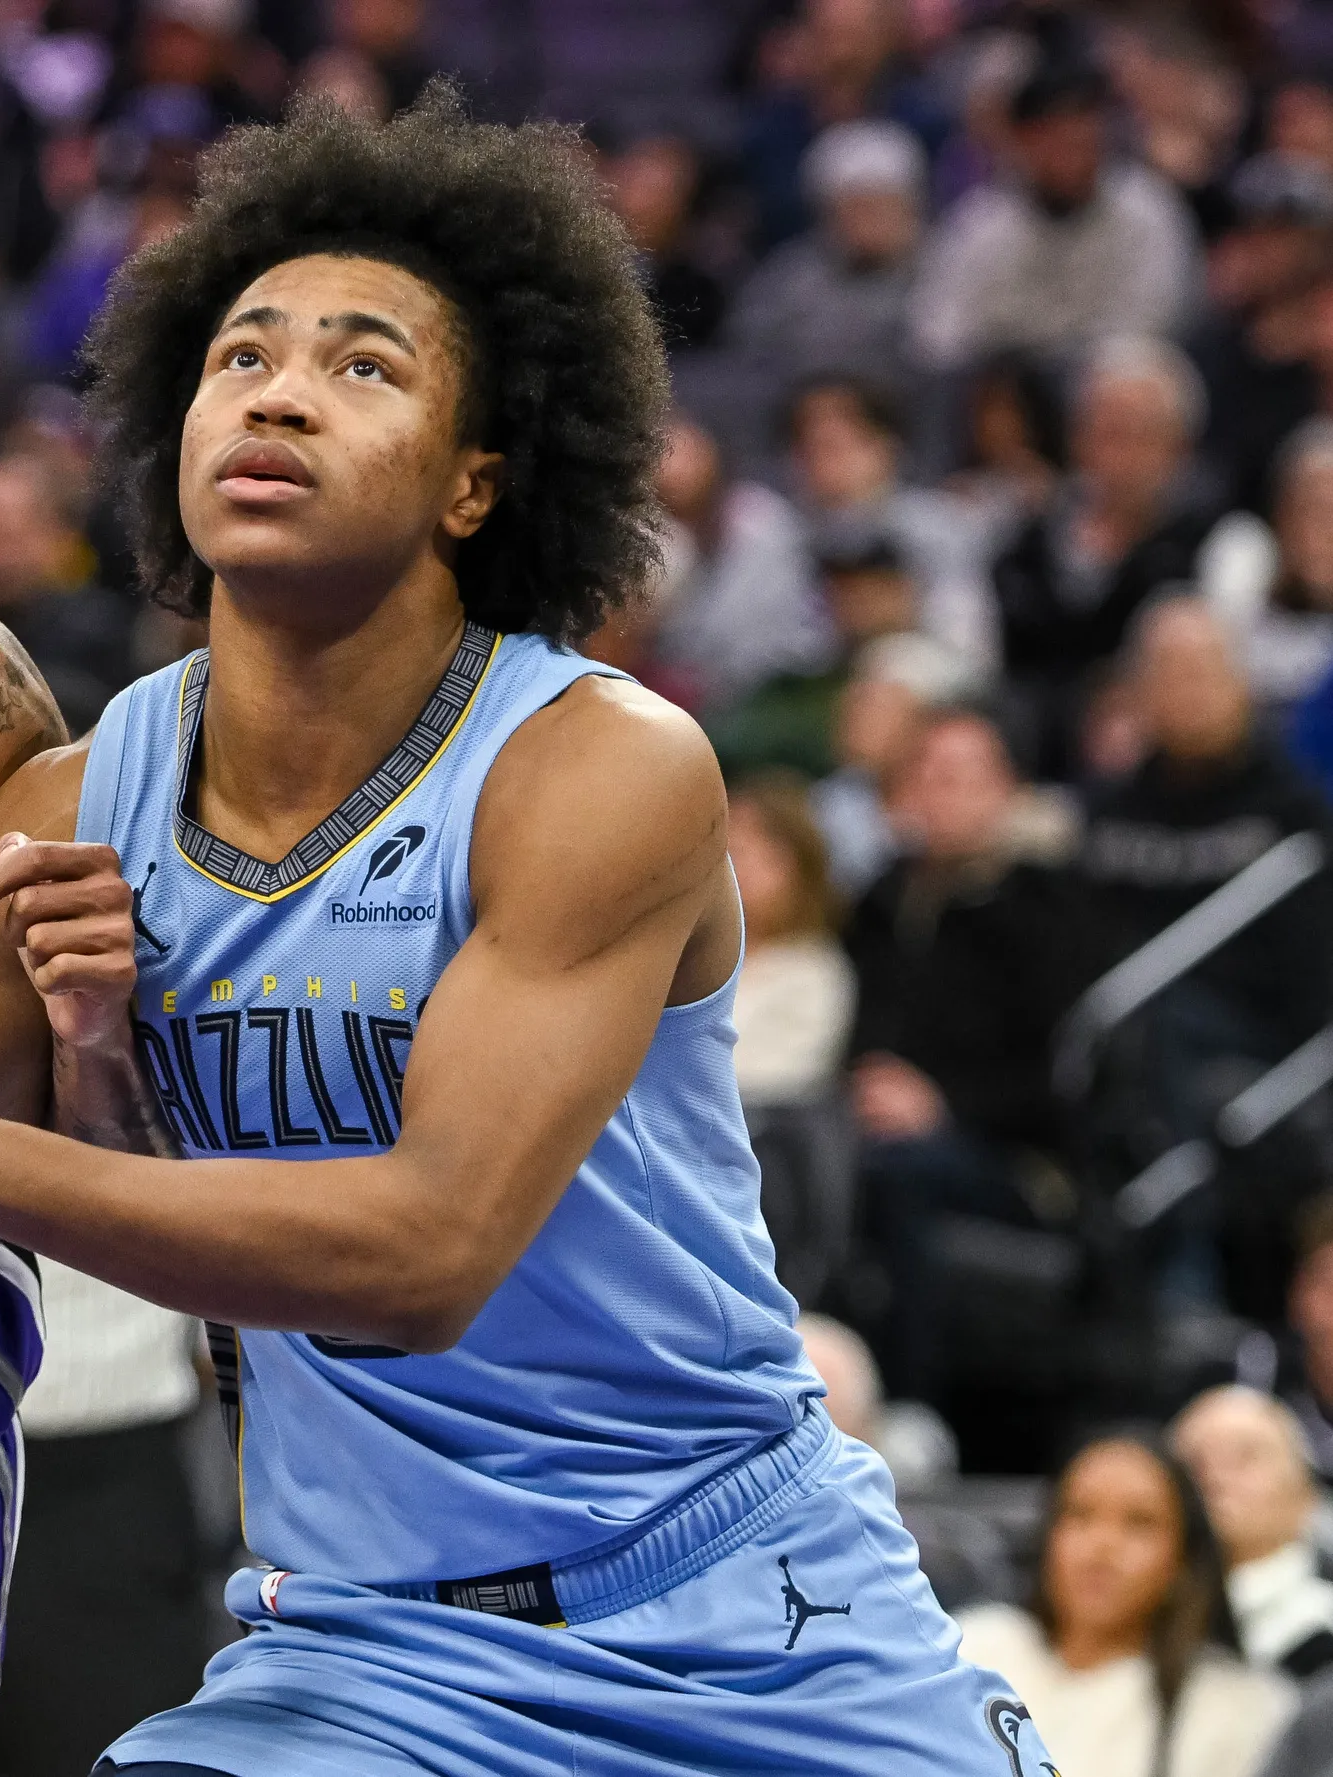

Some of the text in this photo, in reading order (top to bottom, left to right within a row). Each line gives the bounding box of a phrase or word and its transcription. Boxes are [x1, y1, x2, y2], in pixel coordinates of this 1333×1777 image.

[331, 898, 436, 924] Robinhood
[130, 974, 408, 1014] EMPHIS
[132, 995, 431, 1151] RIZZLIE
